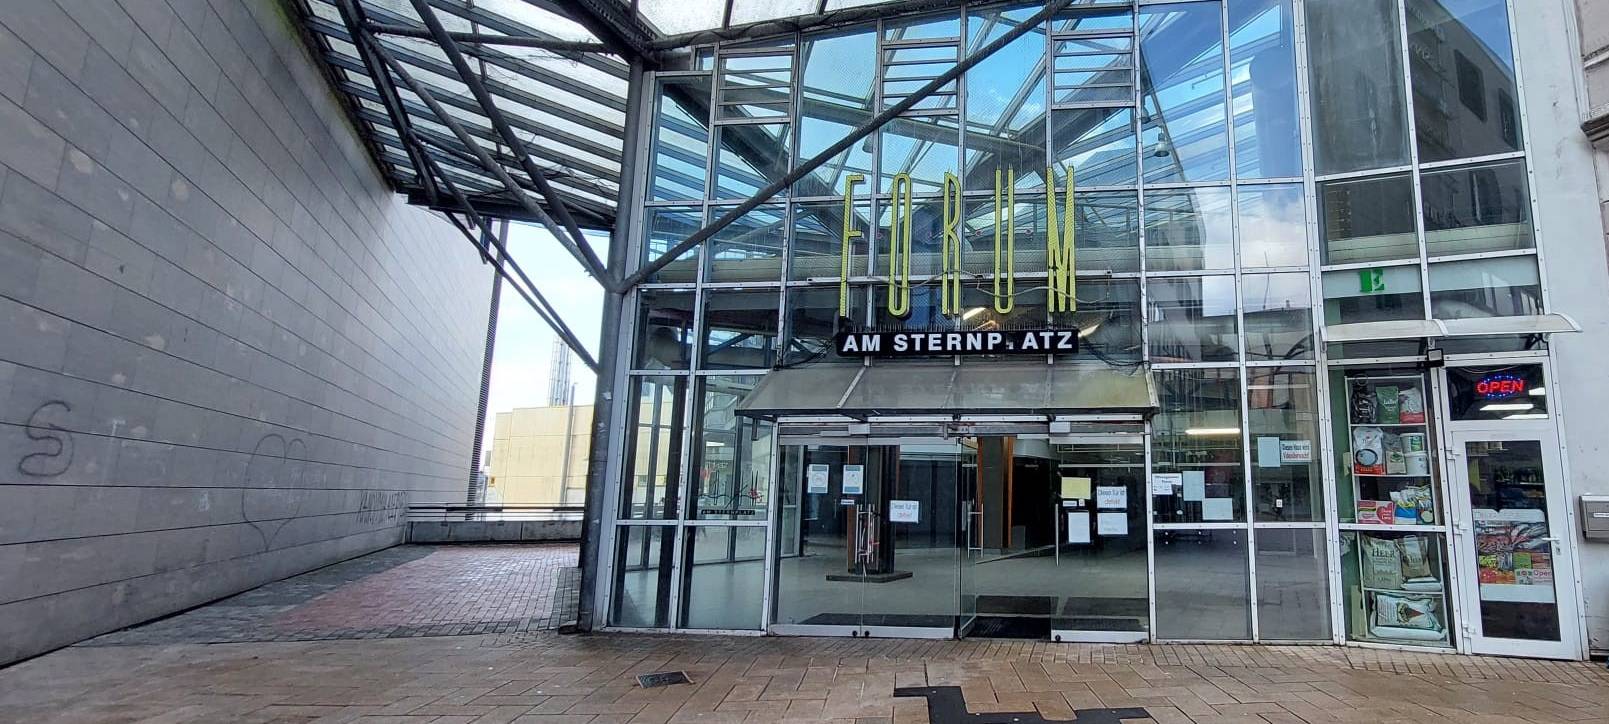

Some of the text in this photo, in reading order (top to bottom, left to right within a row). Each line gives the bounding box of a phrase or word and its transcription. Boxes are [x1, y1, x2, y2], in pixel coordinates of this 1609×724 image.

[839, 165, 1076, 317] FORUM
[843, 334, 881, 352] AM
[1477, 380, 1524, 394] OPEN
